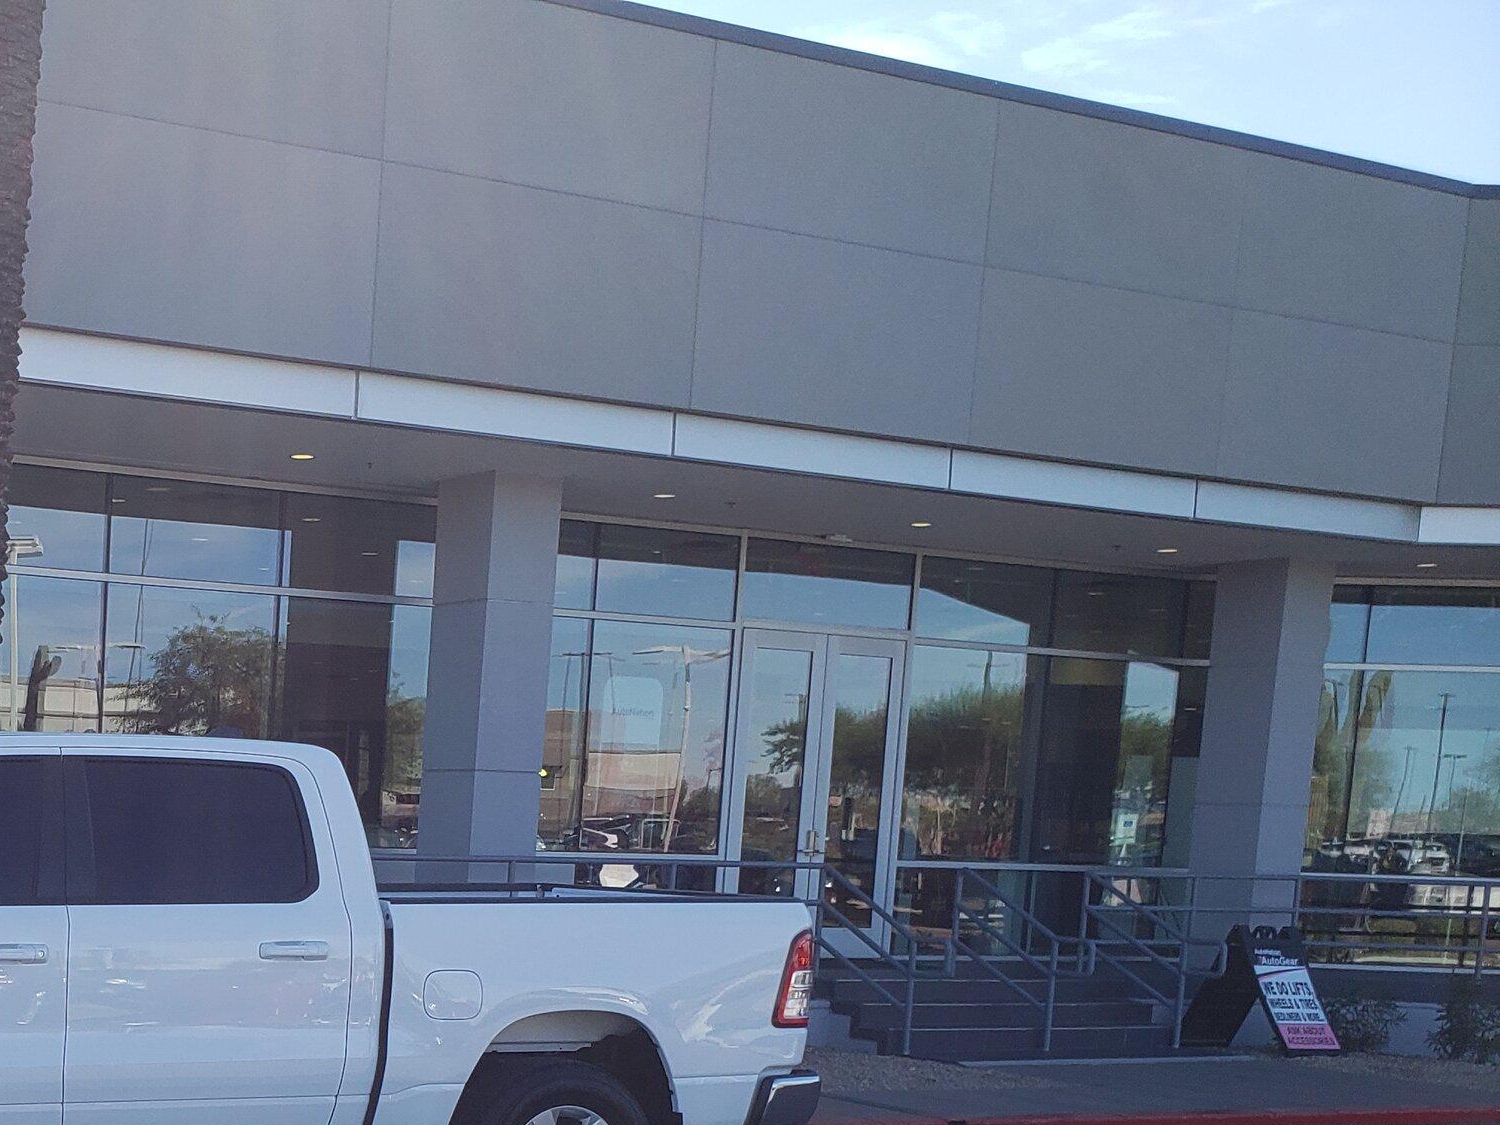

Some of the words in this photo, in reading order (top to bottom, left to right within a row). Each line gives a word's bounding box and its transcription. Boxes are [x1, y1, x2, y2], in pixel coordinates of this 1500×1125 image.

[1261, 957, 1298, 965] AutoGear
[1262, 981, 1277, 996] WE
[1276, 981, 1289, 996] DO
